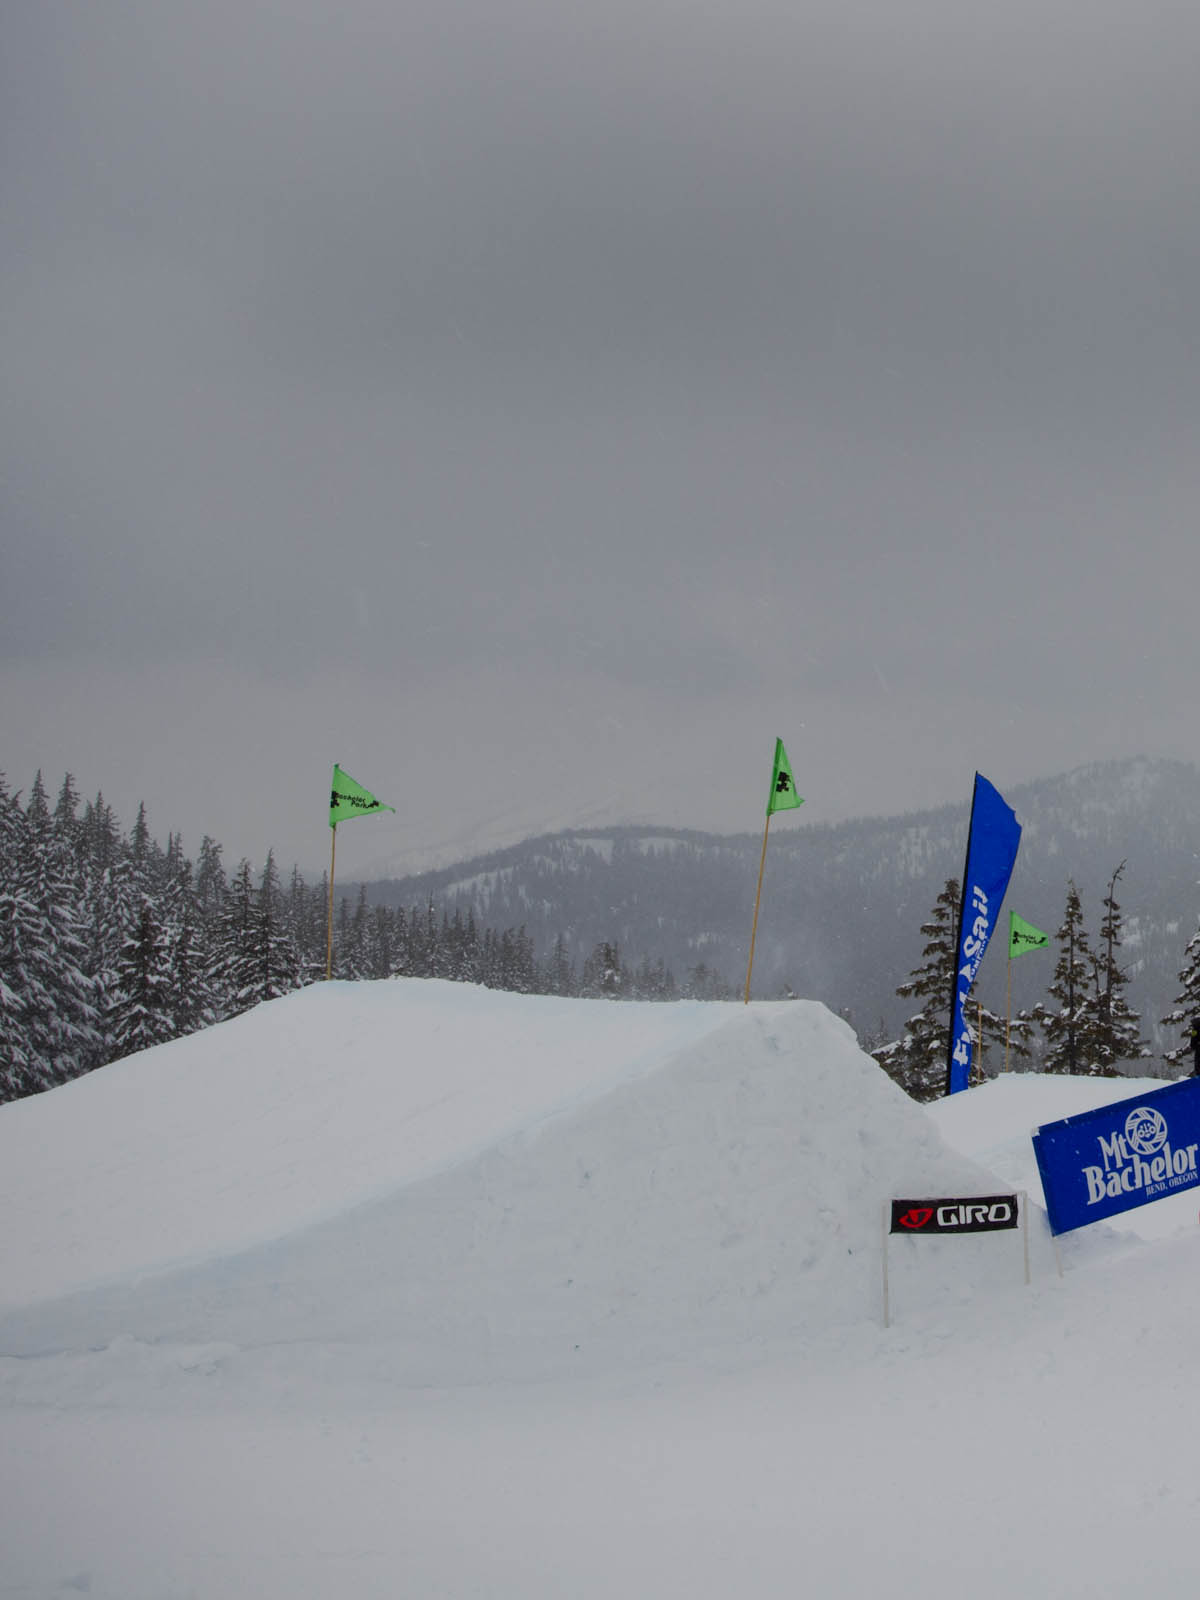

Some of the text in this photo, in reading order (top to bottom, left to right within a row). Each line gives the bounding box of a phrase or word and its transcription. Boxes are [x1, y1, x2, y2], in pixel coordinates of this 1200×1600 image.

[963, 884, 990, 958] Sail
[1082, 1142, 1199, 1206] Bachelor
[1146, 1170, 1199, 1198] BEND, OREGON
[937, 1203, 1011, 1227] GIRO
